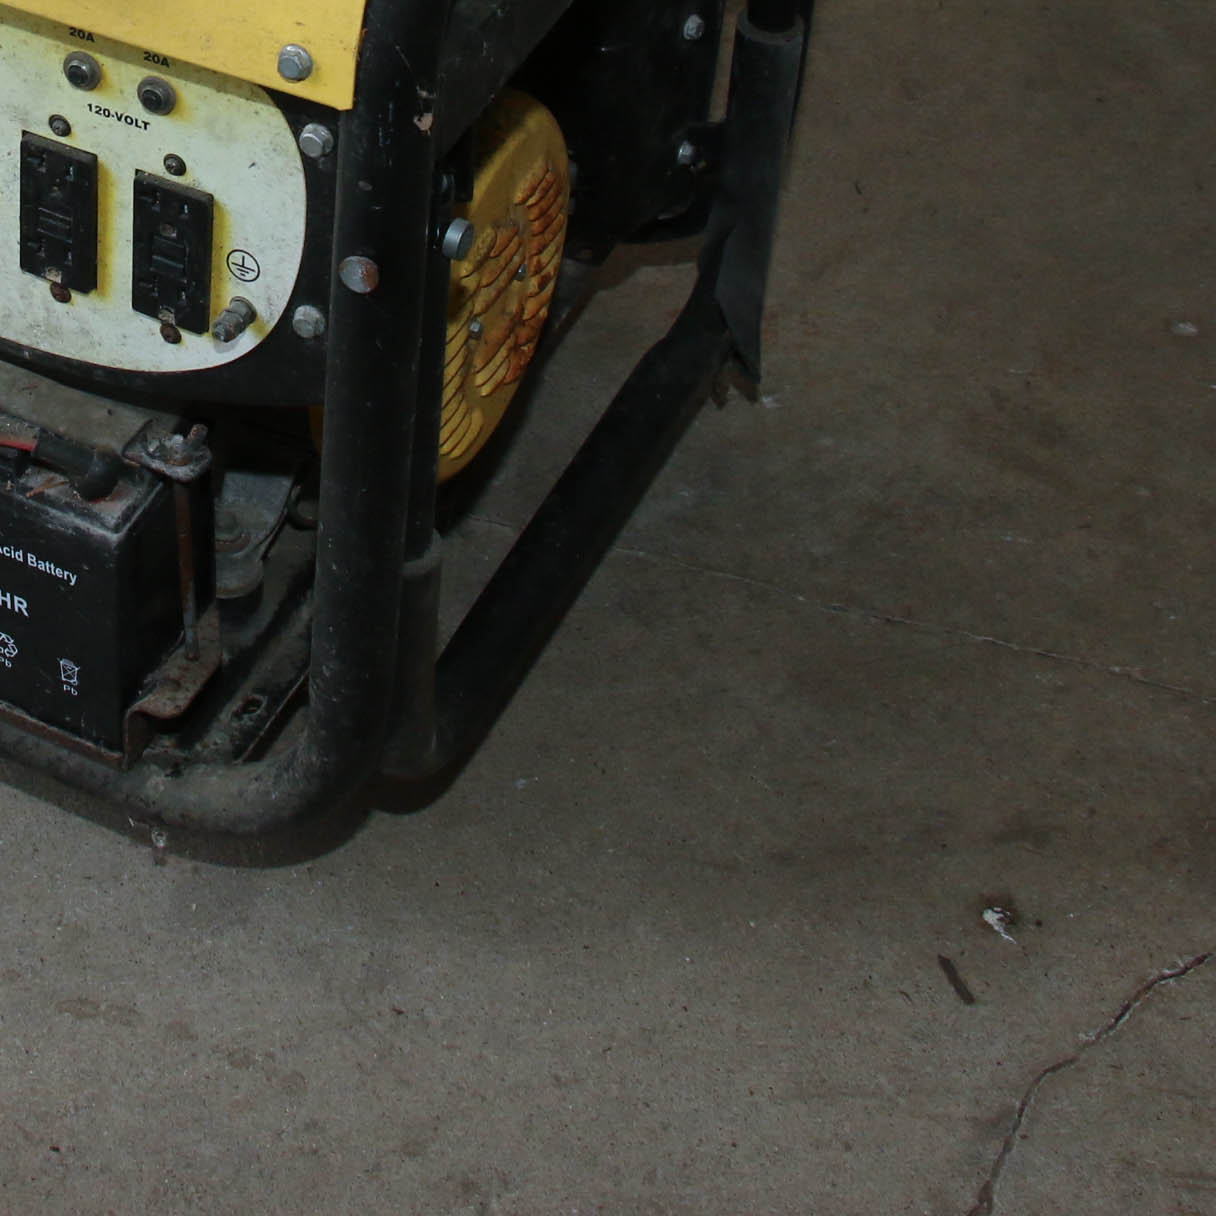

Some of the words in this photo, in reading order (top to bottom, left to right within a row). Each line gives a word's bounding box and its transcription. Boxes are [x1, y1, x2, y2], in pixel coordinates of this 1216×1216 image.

[68, 26, 96, 44] 20A
[143, 50, 170, 69] 20A
[86, 102, 151, 132] 120-VOLT
[27, 552, 77, 586] Battery
[63, 685, 78, 696] Pb
